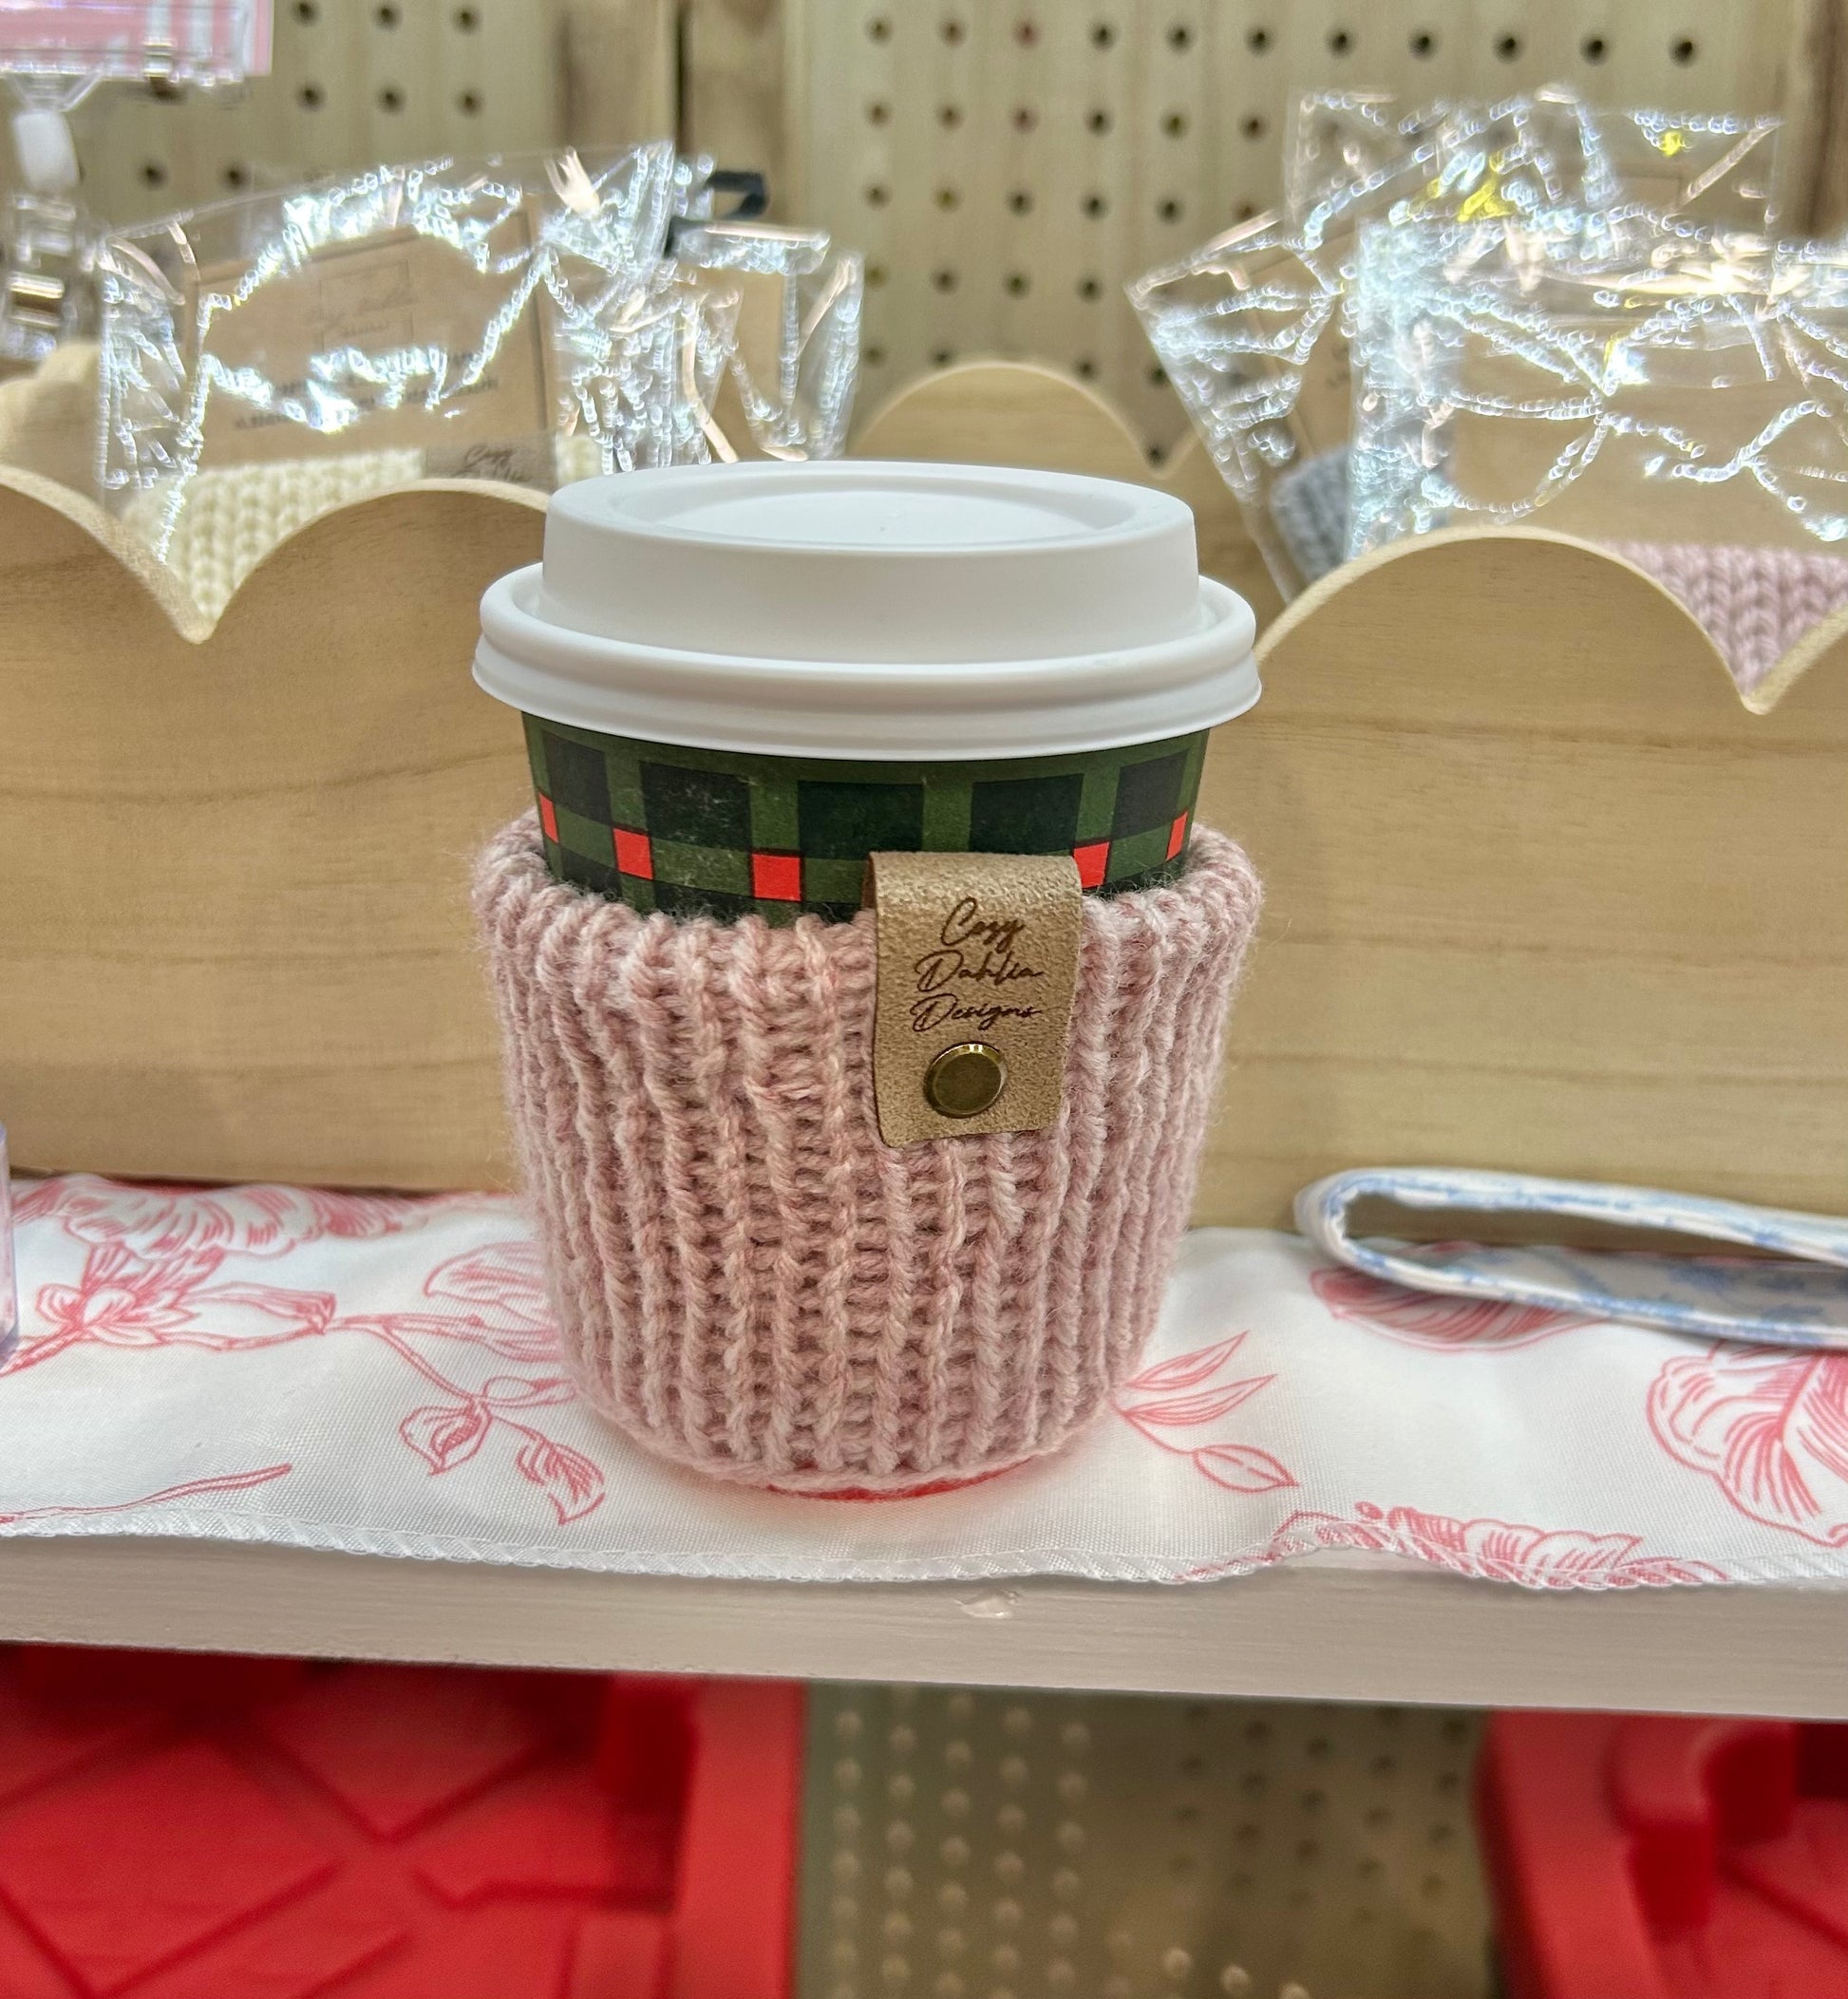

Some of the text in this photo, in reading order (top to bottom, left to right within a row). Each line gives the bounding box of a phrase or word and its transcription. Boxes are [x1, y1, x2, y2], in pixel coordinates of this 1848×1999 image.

[941, 896, 1026, 953] Cozy
[915, 950, 1043, 992] Dahlia
[911, 993, 1042, 1032] Designs
